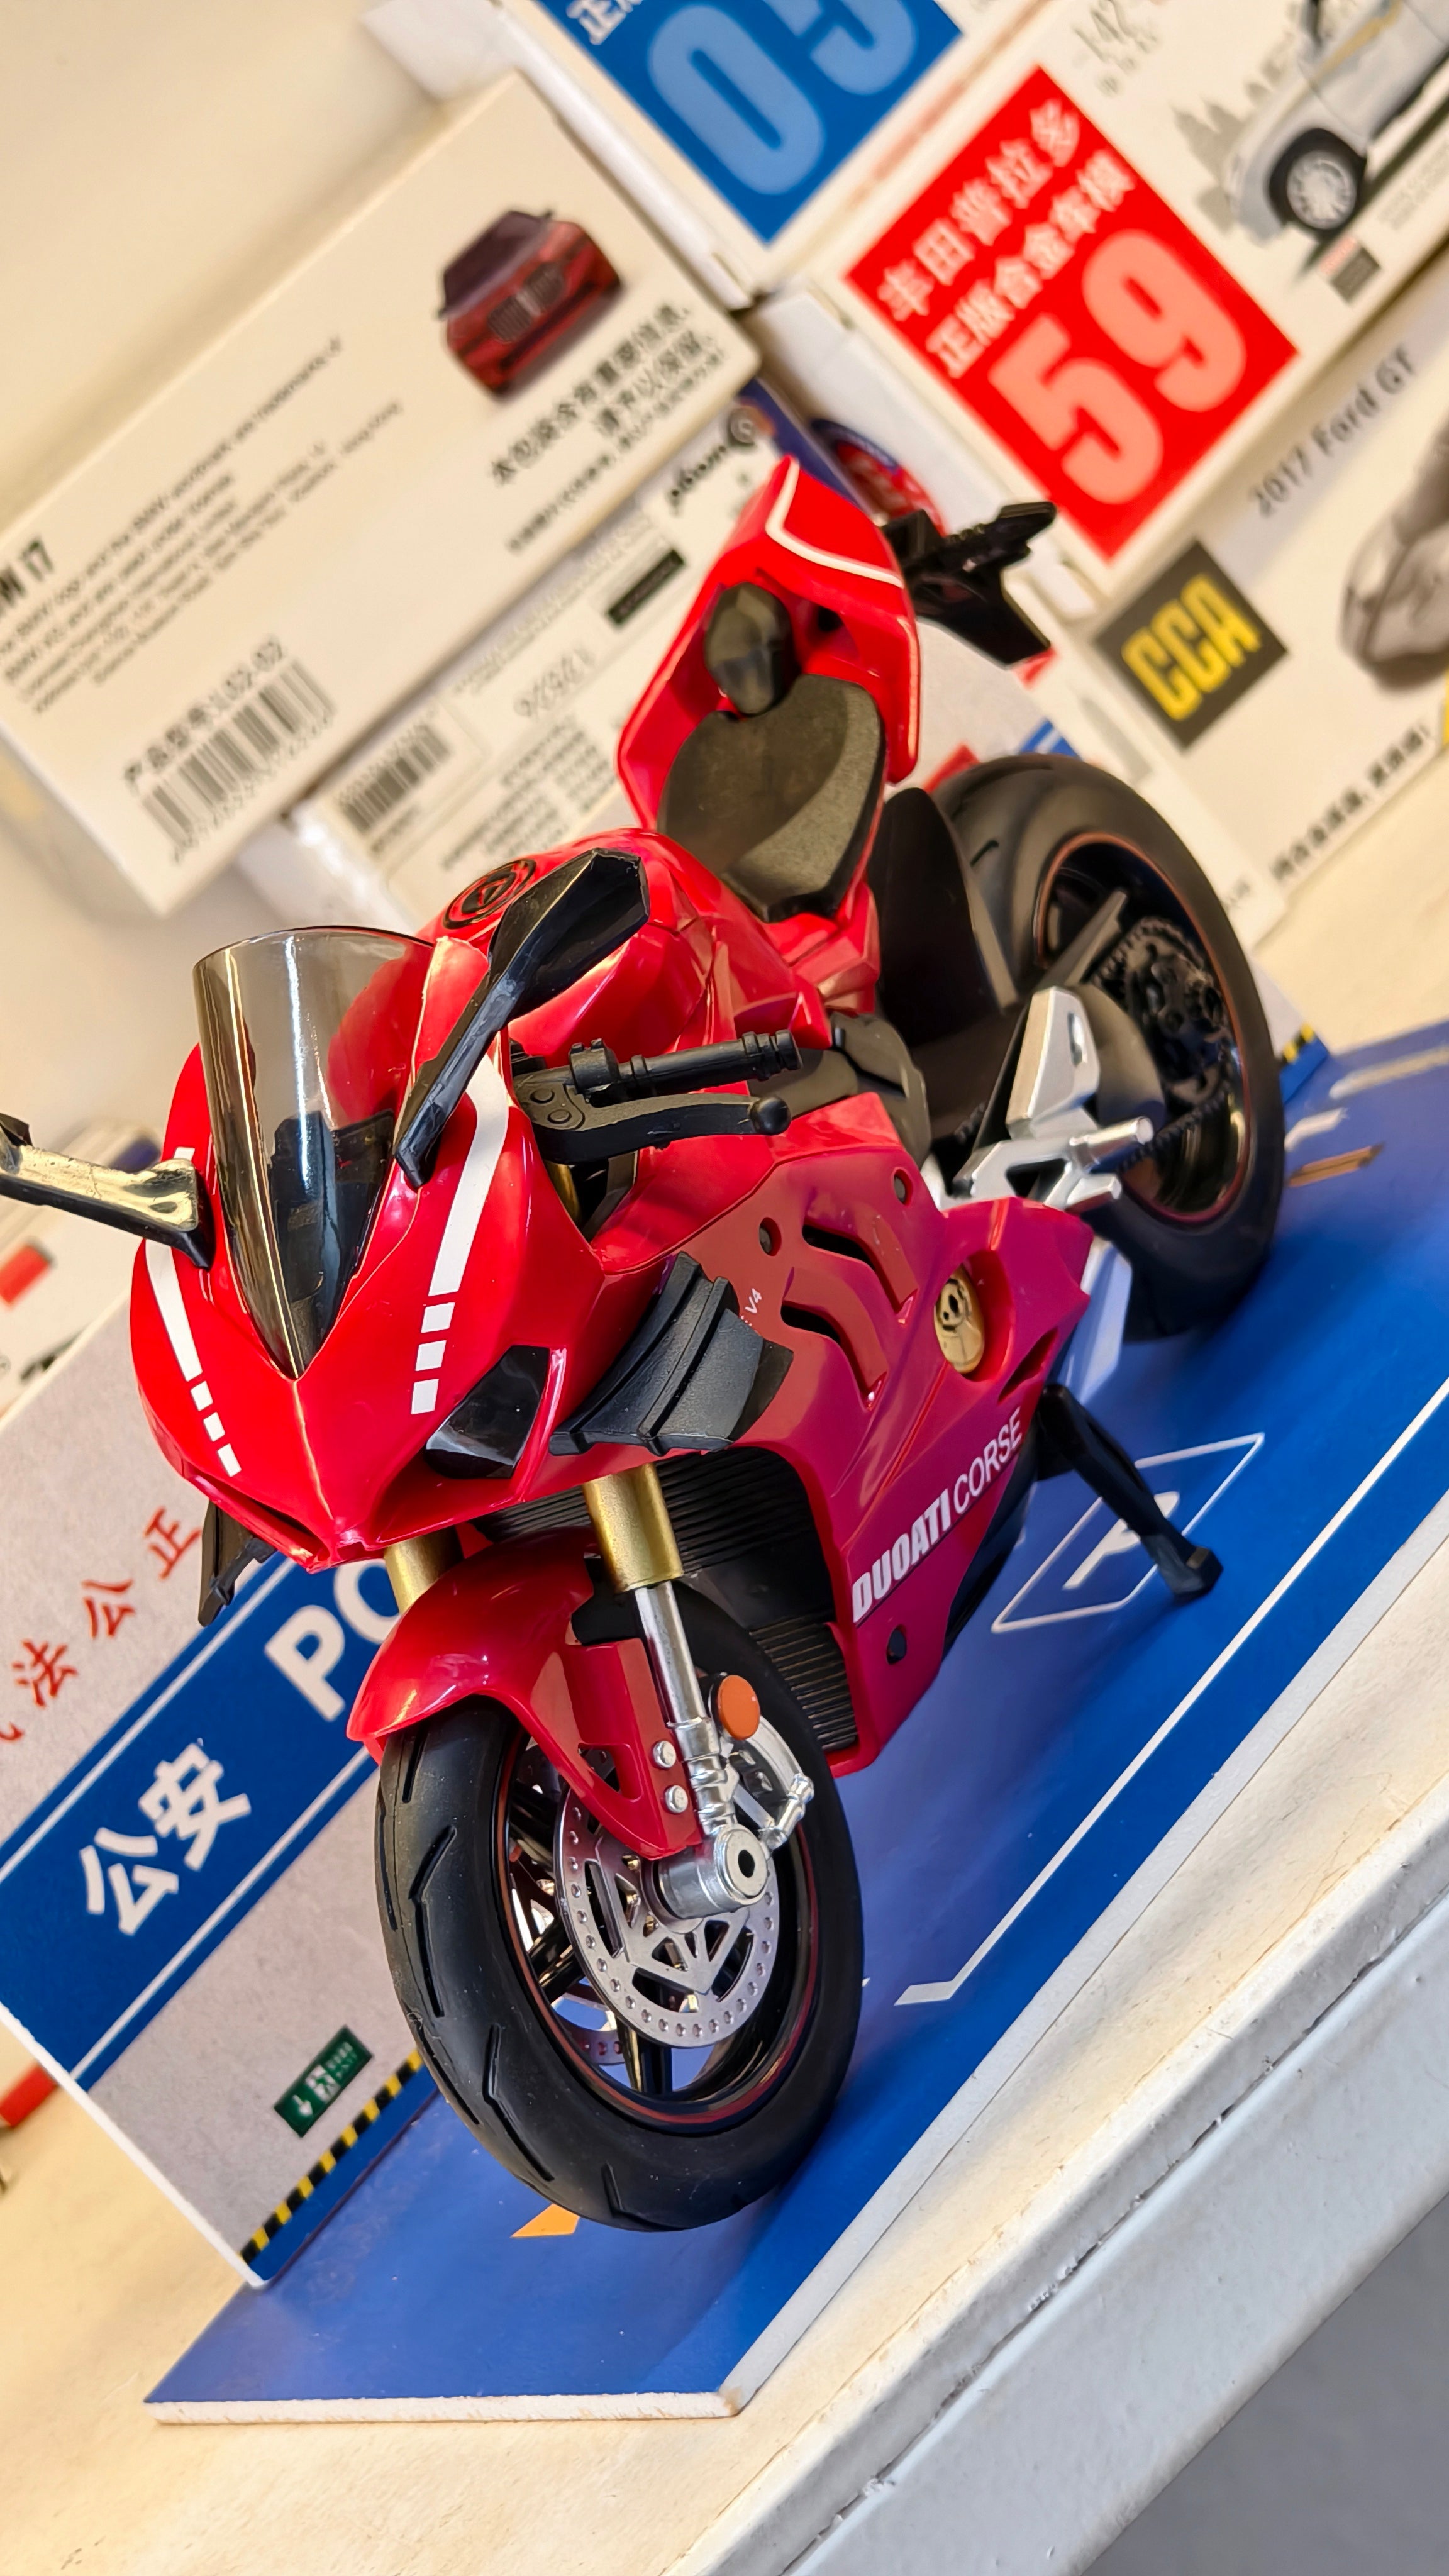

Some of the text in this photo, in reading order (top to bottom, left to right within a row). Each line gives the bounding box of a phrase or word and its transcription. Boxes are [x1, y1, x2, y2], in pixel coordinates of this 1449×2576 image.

[878, 97, 1080, 321] 丰田普拉多
[926, 148, 1135, 379] 正版合金车模
[987, 228, 1248, 505] 59
[1248, 343, 1418, 518] 2017 Ford GT
[1121, 572, 1262, 721] CCA
[745, 1288, 762, 1313] V4
[953, 1407, 1023, 1514] CORSE
[0, 1507, 201, 1742] 法公正
[79, 1742, 252, 1936] 公安
